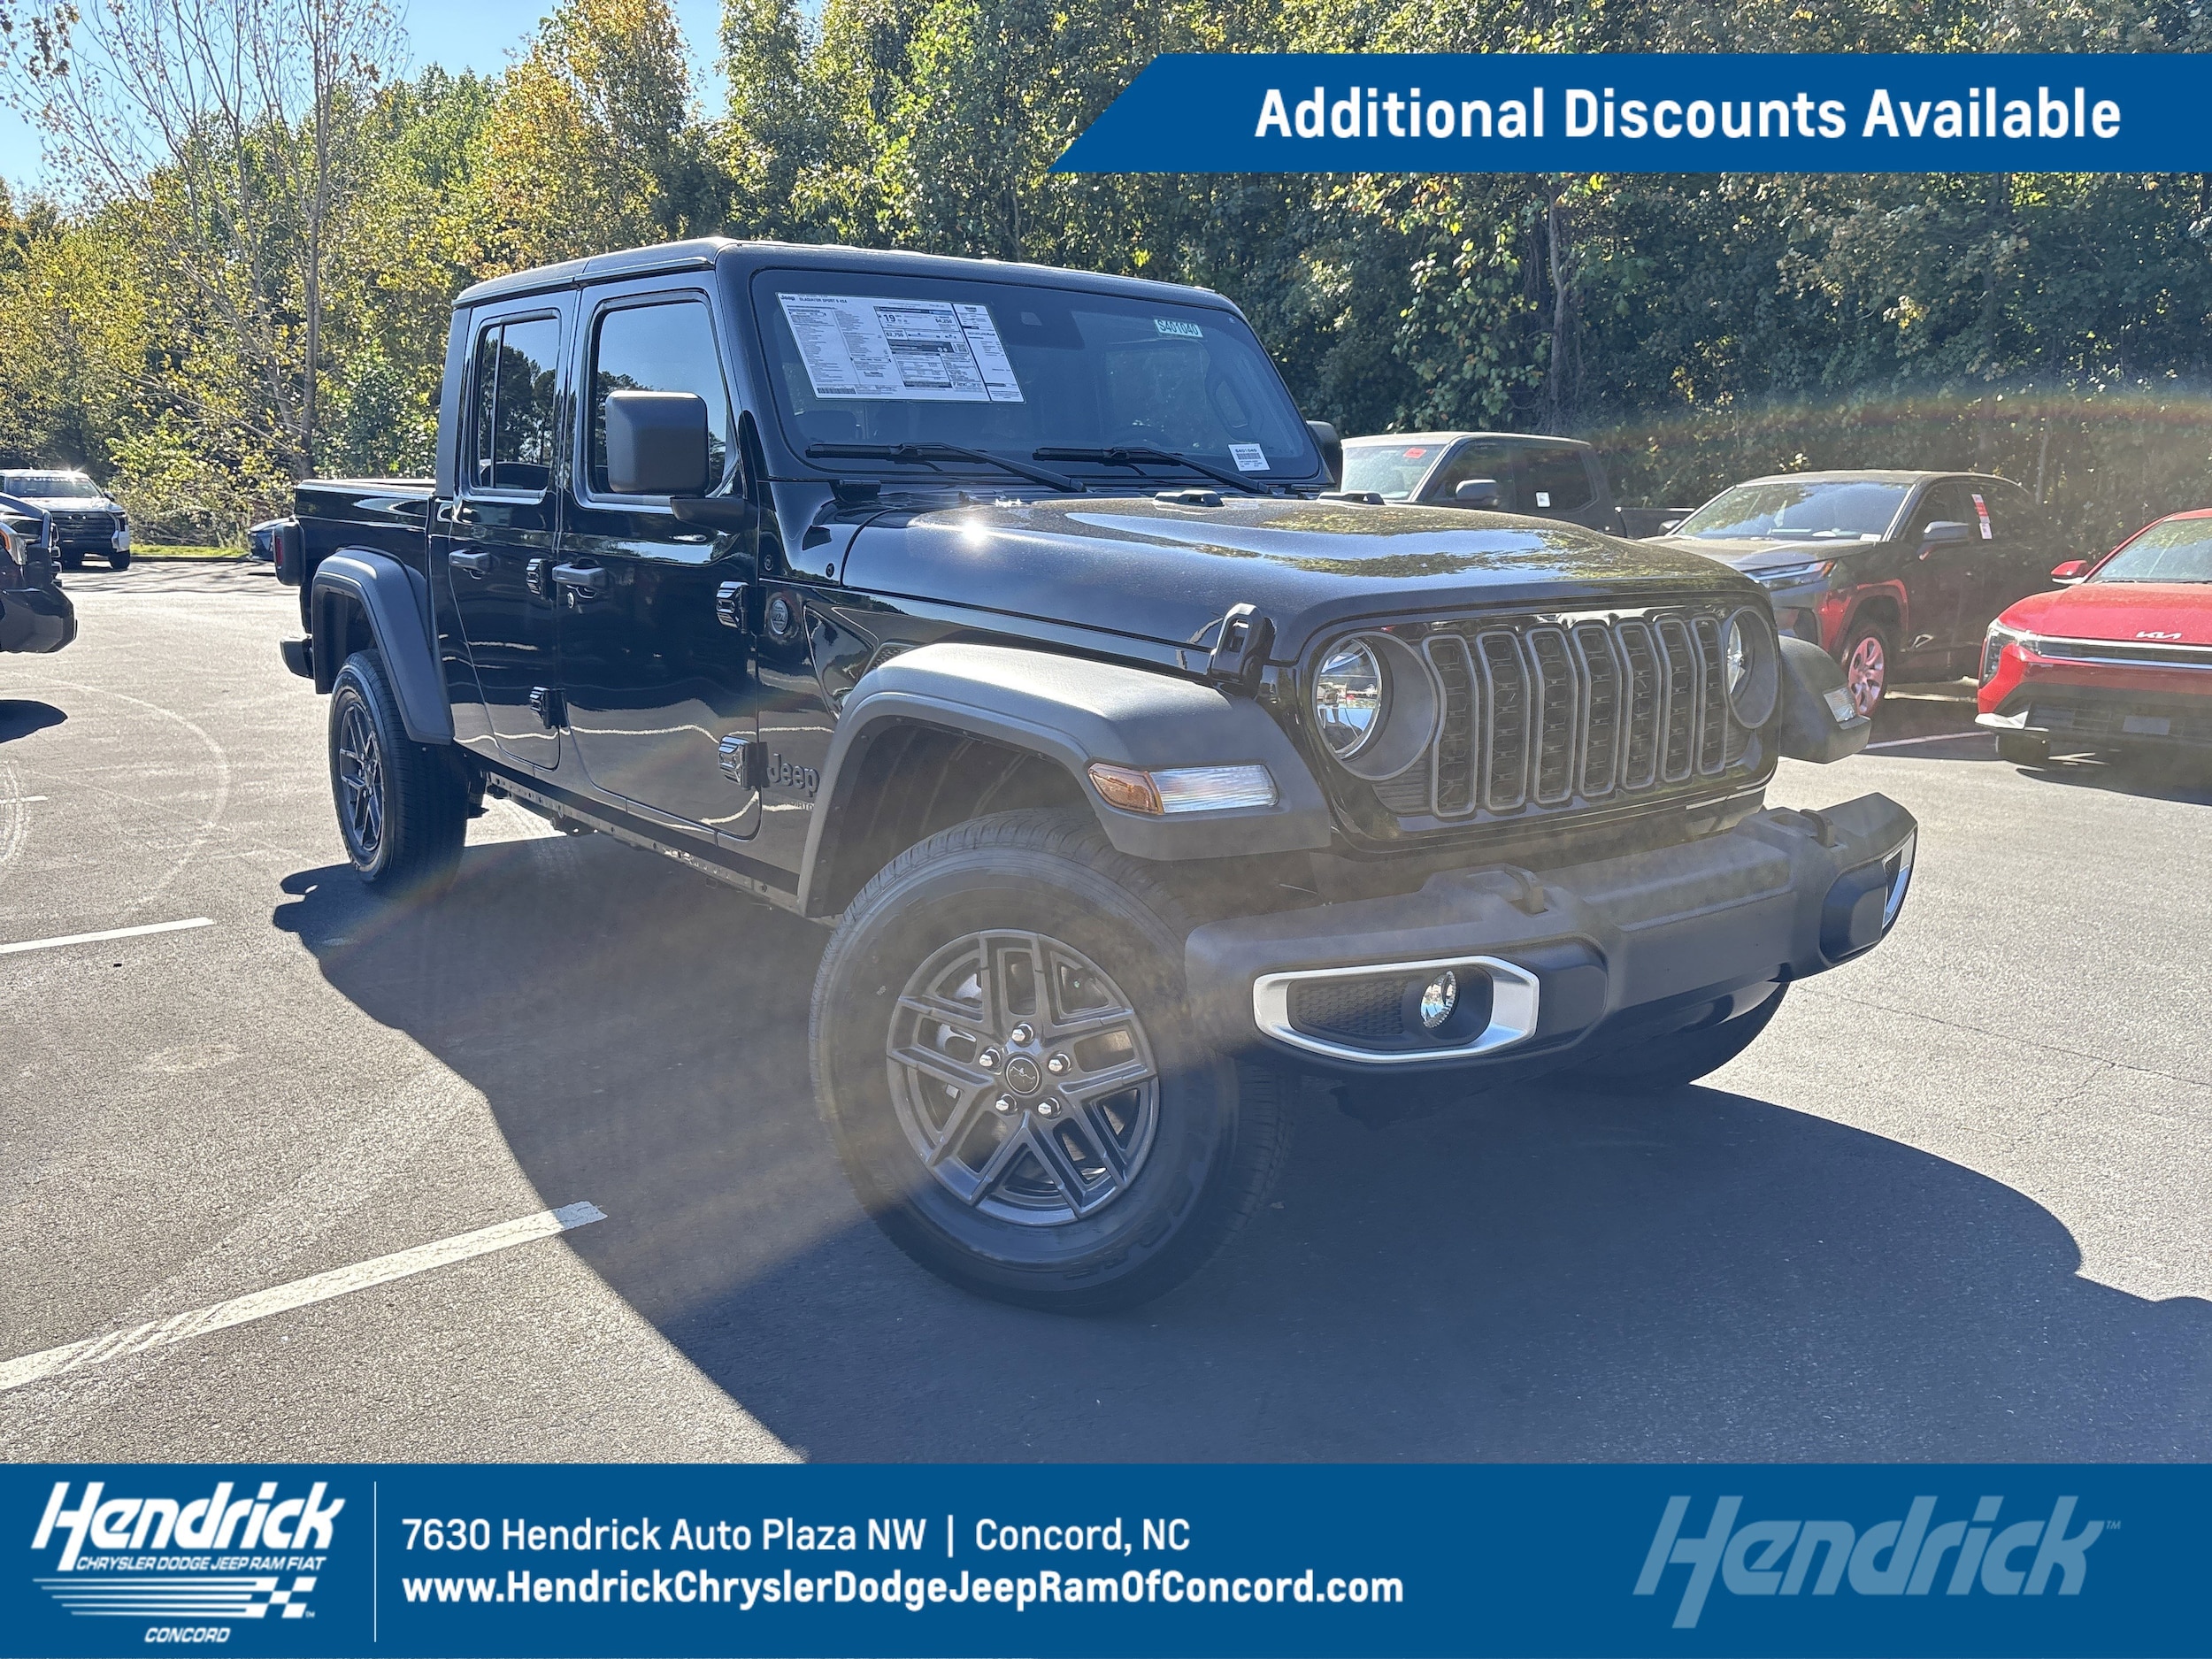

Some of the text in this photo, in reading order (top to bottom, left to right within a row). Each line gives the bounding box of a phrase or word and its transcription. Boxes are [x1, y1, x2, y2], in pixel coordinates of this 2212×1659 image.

[883, 314, 896, 323] 19
[1157, 319, 1199, 335] S401040
[767, 753, 820, 797] Jeep
